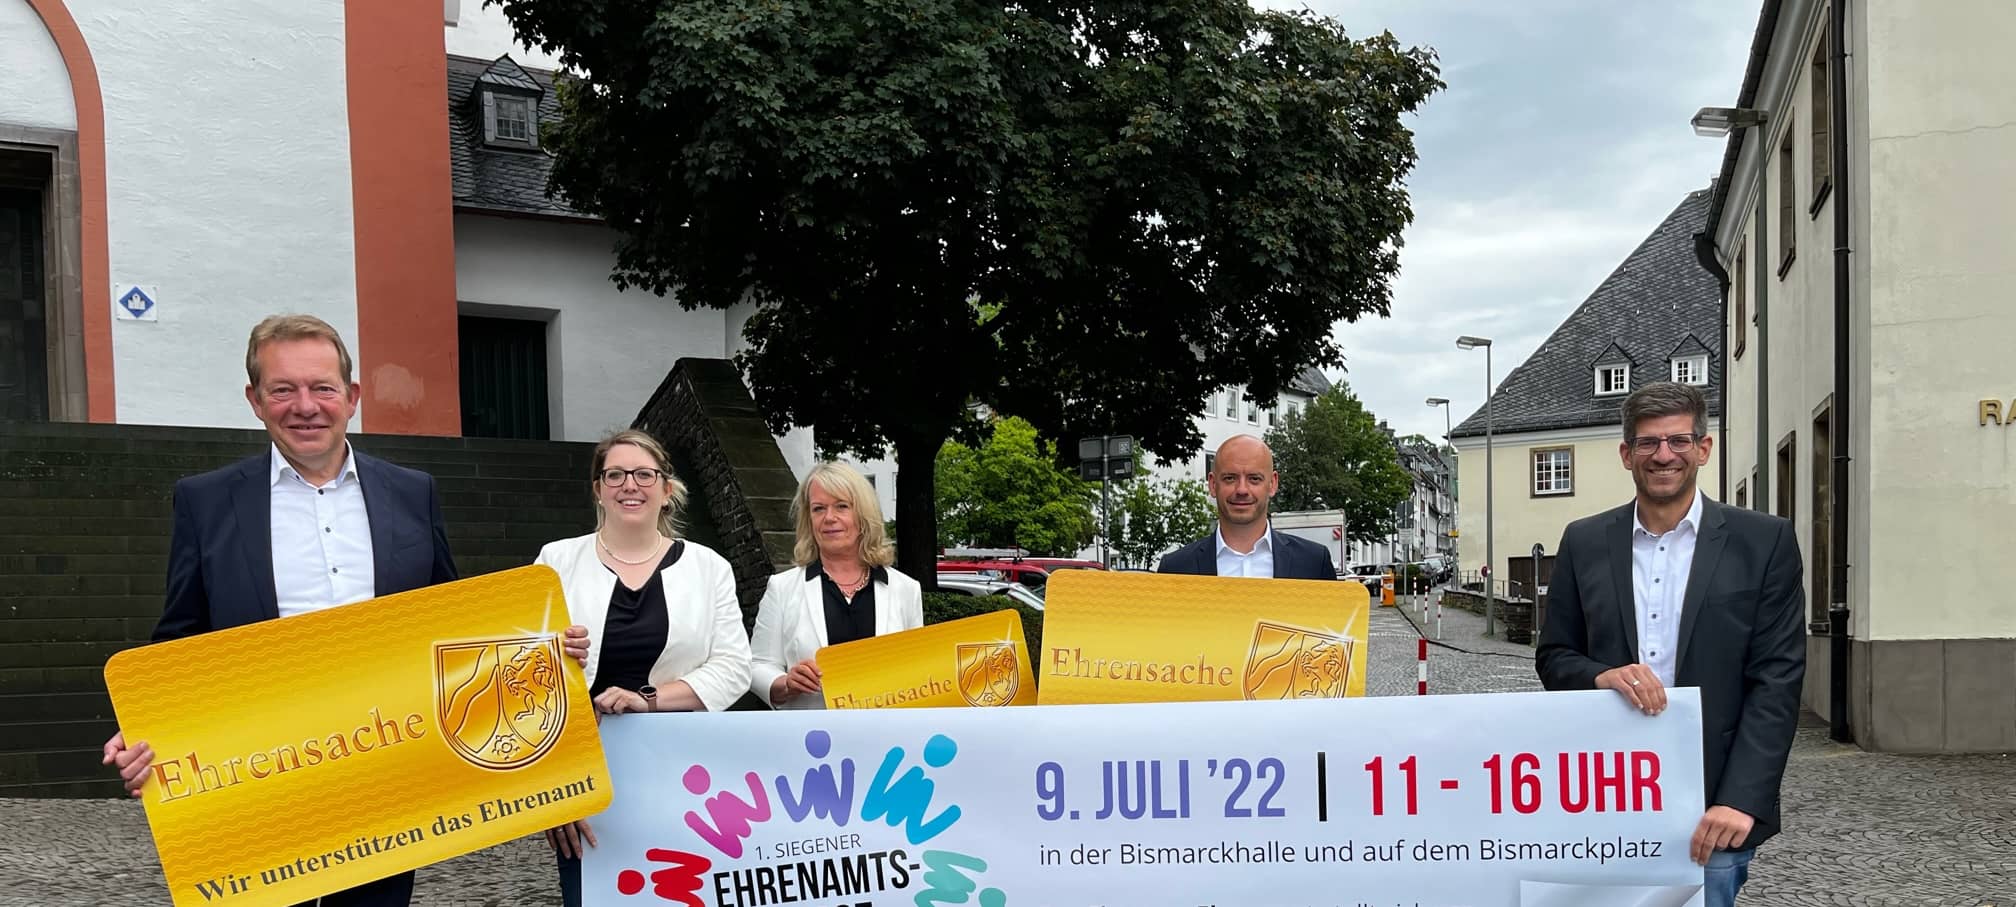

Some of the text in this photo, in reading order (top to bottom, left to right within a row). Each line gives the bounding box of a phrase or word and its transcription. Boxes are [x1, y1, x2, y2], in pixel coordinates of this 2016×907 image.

[1050, 647, 1233, 687] Ehrensache
[151, 706, 427, 804] Ehrensache
[1036, 761, 1080, 821] 9.
[1095, 759, 1190, 820] JULI
[1364, 755, 1418, 816] 11
[1482, 752, 1542, 815] 16
[1558, 751, 1663, 814] UHR
[195, 774, 597, 903] Wir unterstützen das Ehrenamt
[755, 833, 862, 861] 1. SIEGENER
[1040, 836, 1663, 866] in der Bismarckhalle und auf dem Bismarckplatz
[713, 849, 921, 907] EHRENAMTS-
